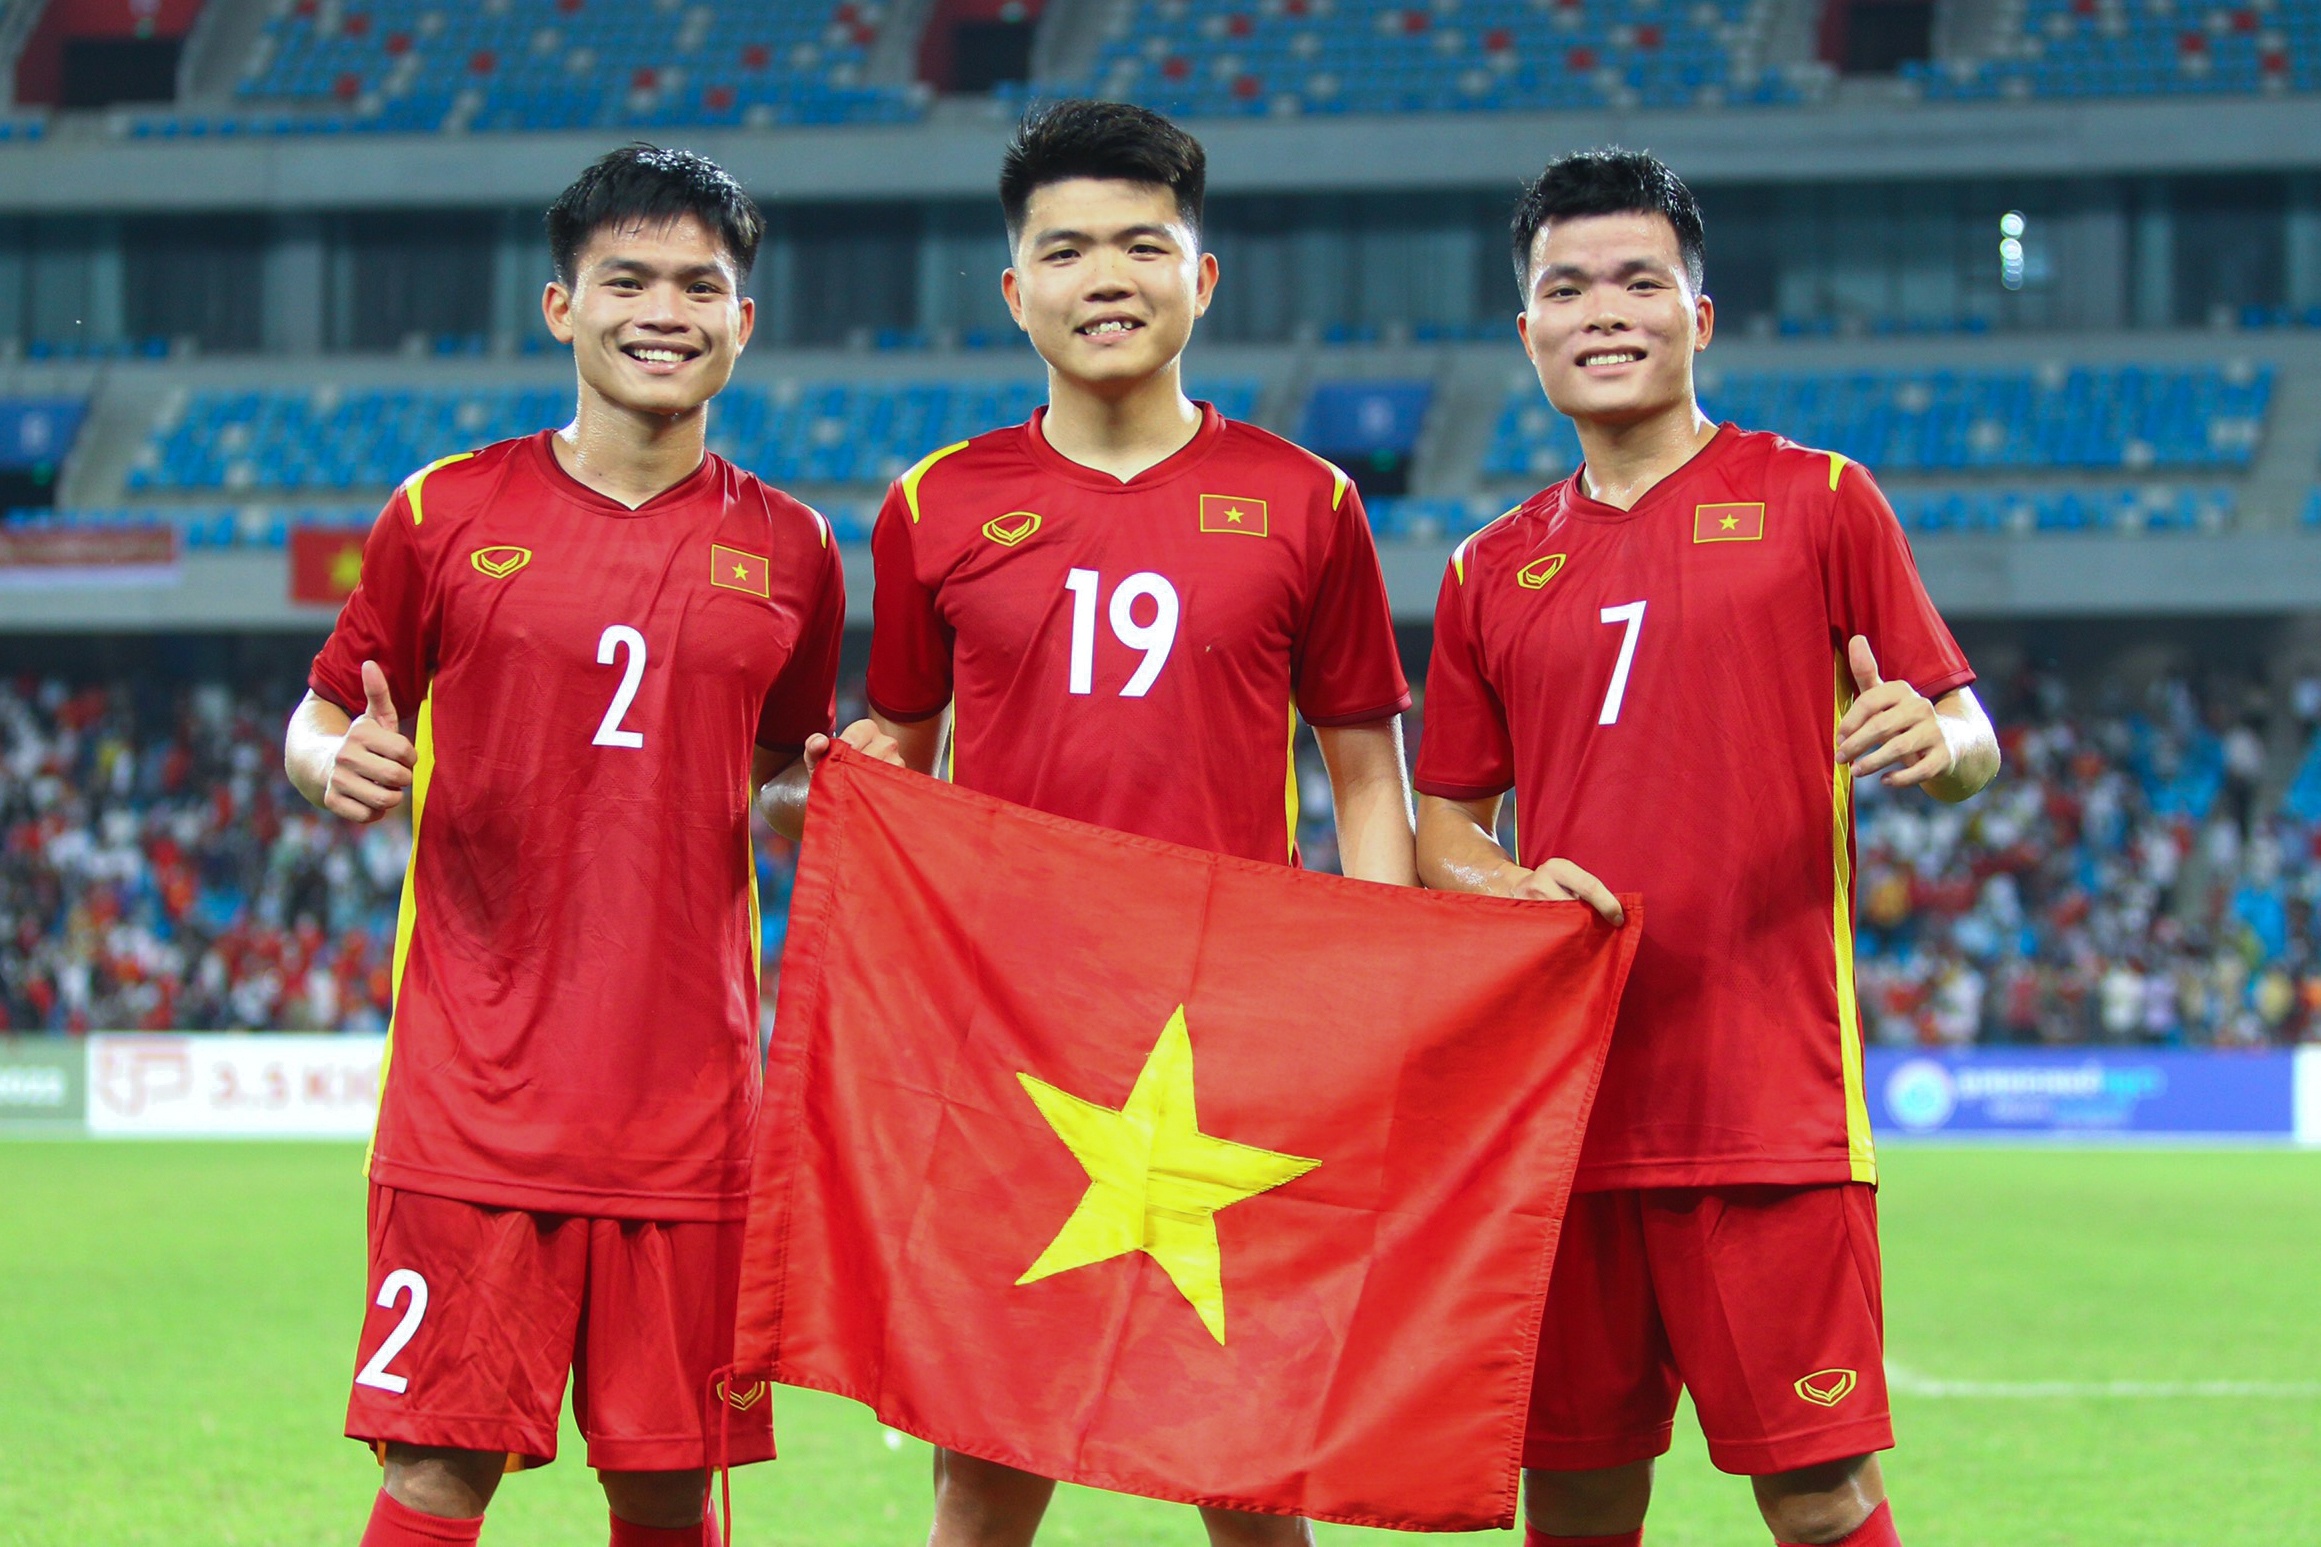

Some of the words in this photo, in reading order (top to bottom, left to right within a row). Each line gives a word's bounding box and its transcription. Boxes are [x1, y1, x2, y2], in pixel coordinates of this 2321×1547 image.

[592, 625, 646, 748] 2
[1066, 569, 1179, 696] 19
[1599, 601, 1646, 725] 7
[356, 1269, 428, 1393] 2
